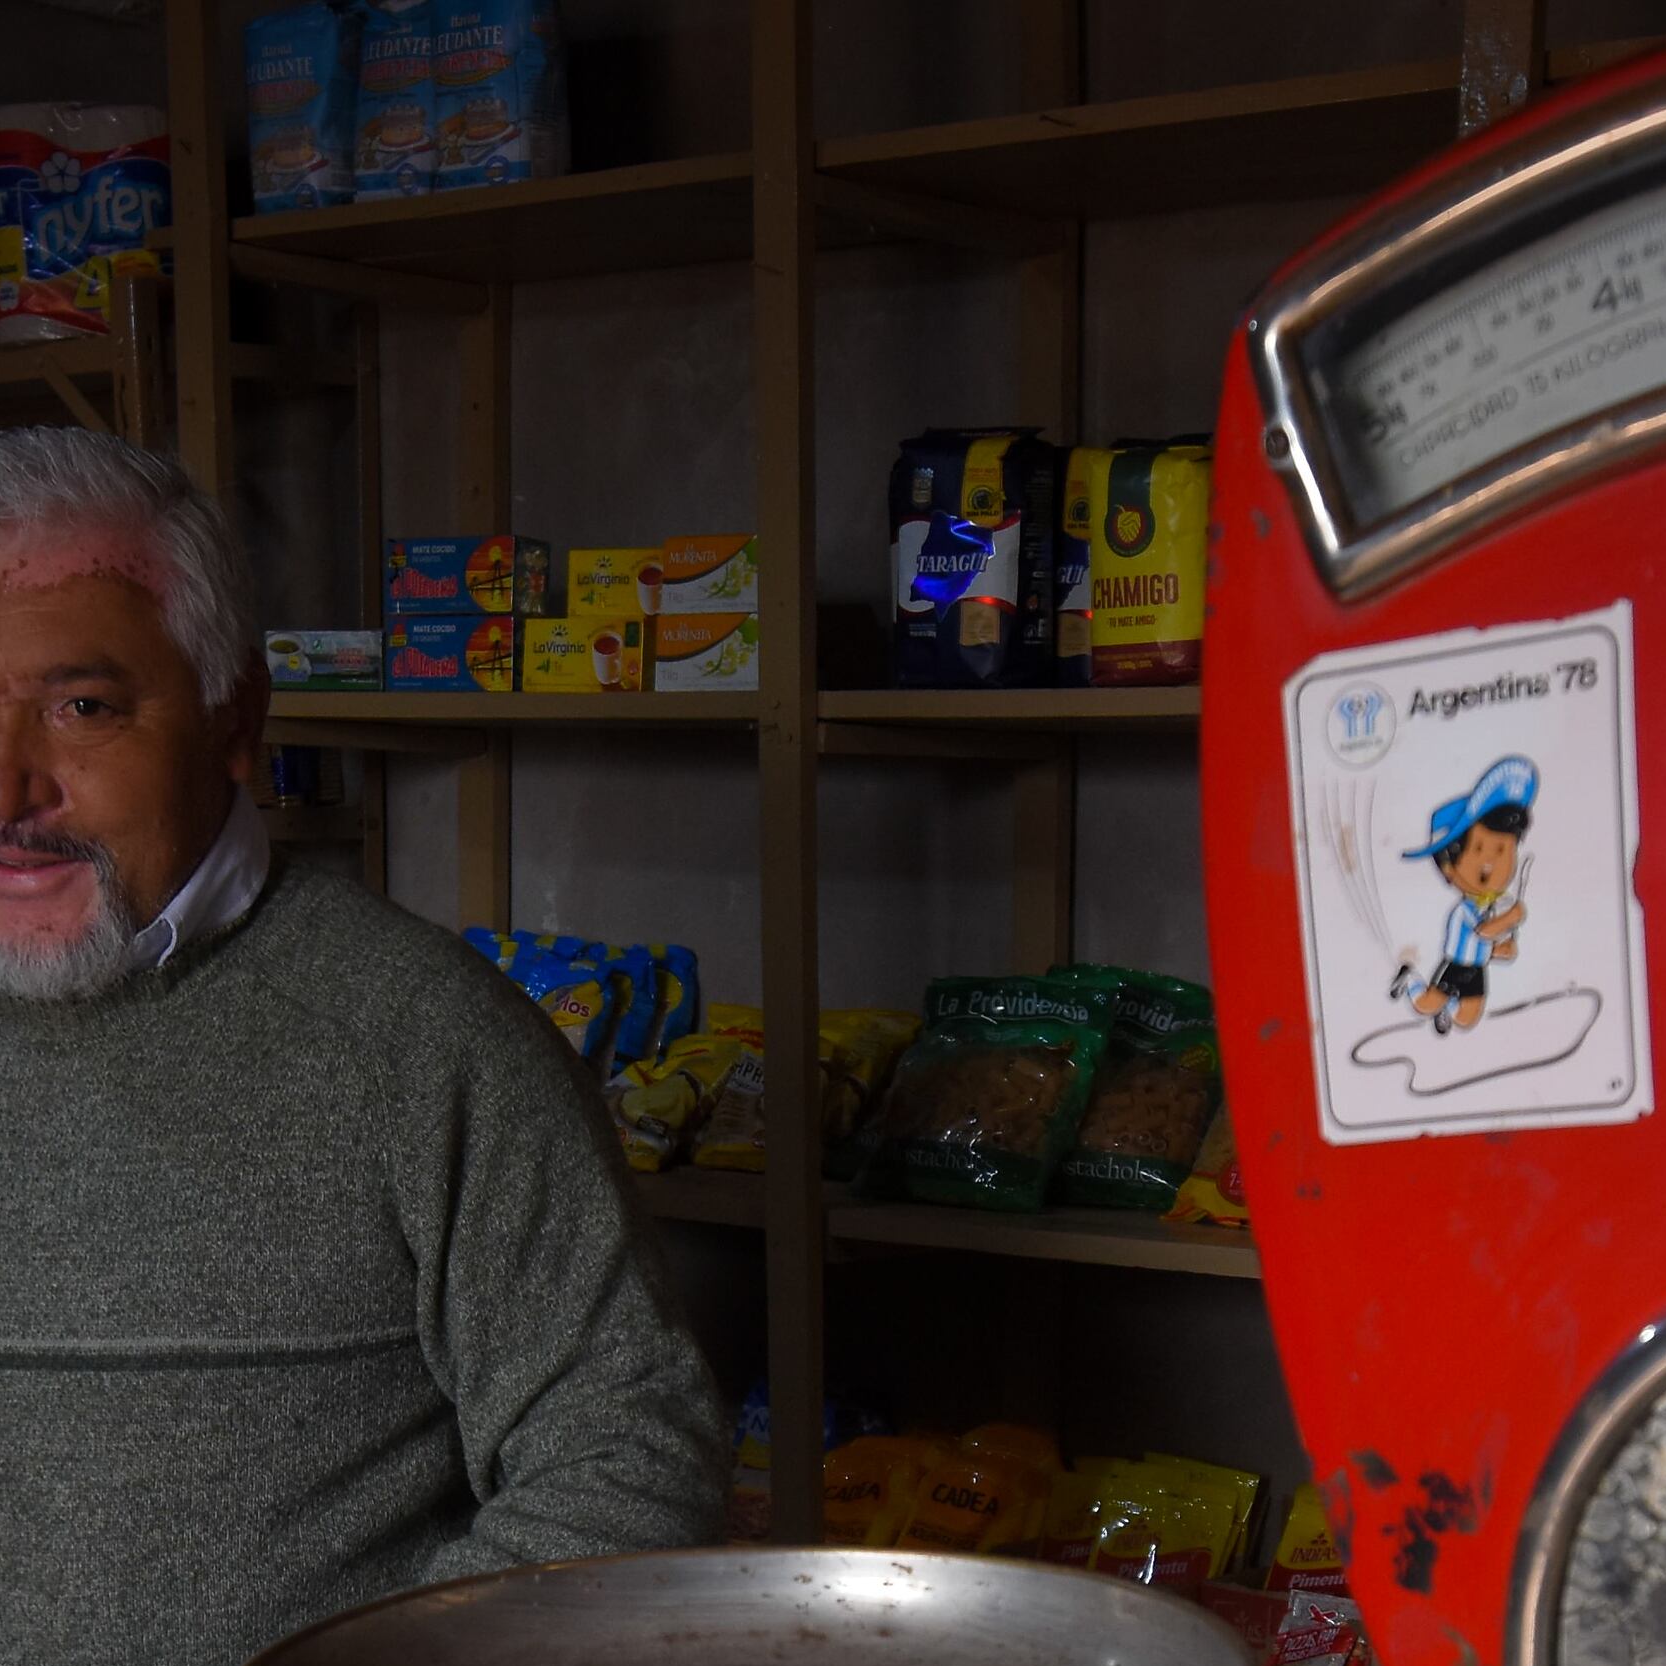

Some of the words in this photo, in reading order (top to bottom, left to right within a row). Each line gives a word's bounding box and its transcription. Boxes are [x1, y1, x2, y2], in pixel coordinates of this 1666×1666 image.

[36, 173, 162, 264] nyfer
[412, 544, 432, 554] MATE
[434, 543, 457, 553] COCIDO
[668, 549, 717, 564] MORENITA
[1093, 573, 1179, 610] CHAMIGO
[413, 624, 432, 633] MATE
[434, 623, 457, 633] COCIDO
[1135, 615, 1156, 626] AMIGO
[662, 629, 712, 642] MORENITA
[1407, 674, 1551, 722] Argentina
[937, 992, 959, 1016] La
[932, 1482, 999, 1518] CADEA
